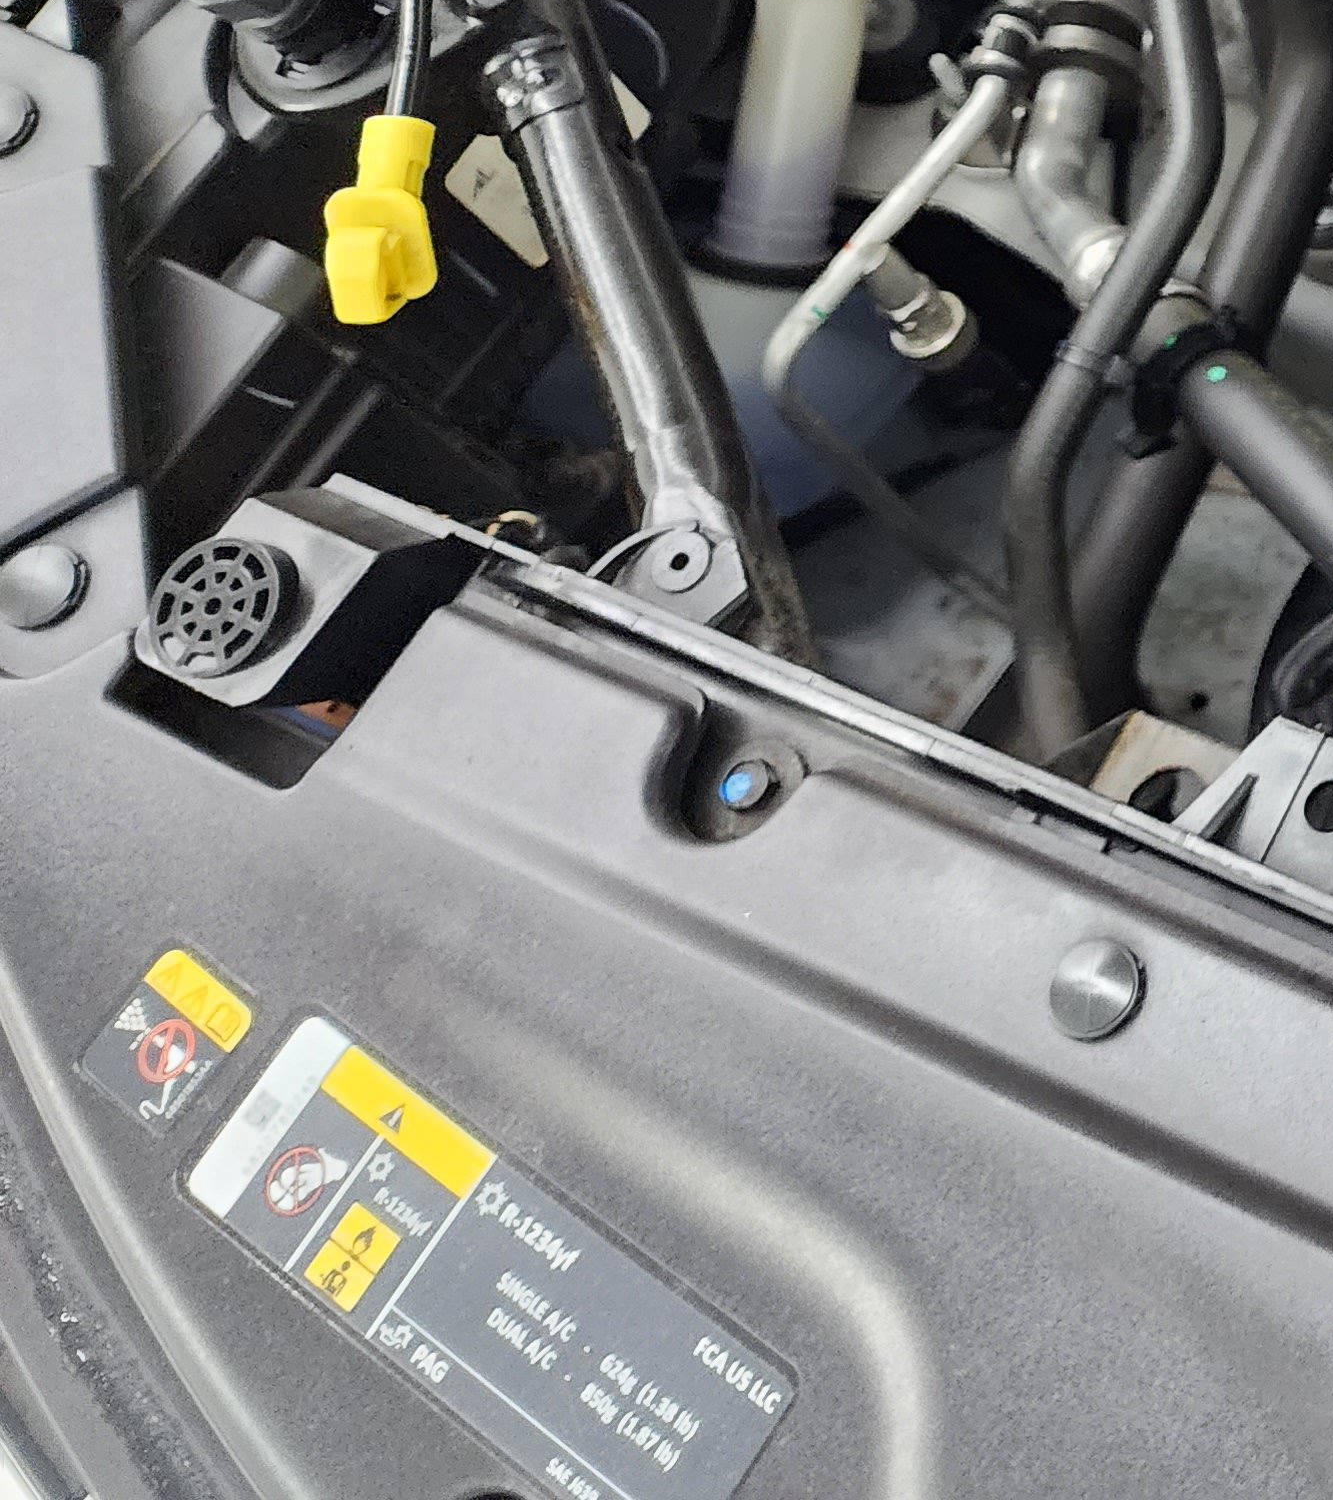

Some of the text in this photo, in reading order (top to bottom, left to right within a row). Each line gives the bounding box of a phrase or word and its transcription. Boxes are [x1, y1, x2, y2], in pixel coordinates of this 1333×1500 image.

[495, 1270, 577, 1343] SINGLE A/C
[486, 1307, 558, 1371] DUAL A/C
[409, 1343, 449, 1383] PAG
[600, 1353, 639, 1396] 624g
[692, 1335, 782, 1415] FCA US LLC
[580, 1382, 619, 1425] 850g
[545, 1457, 573, 1485] SAE
